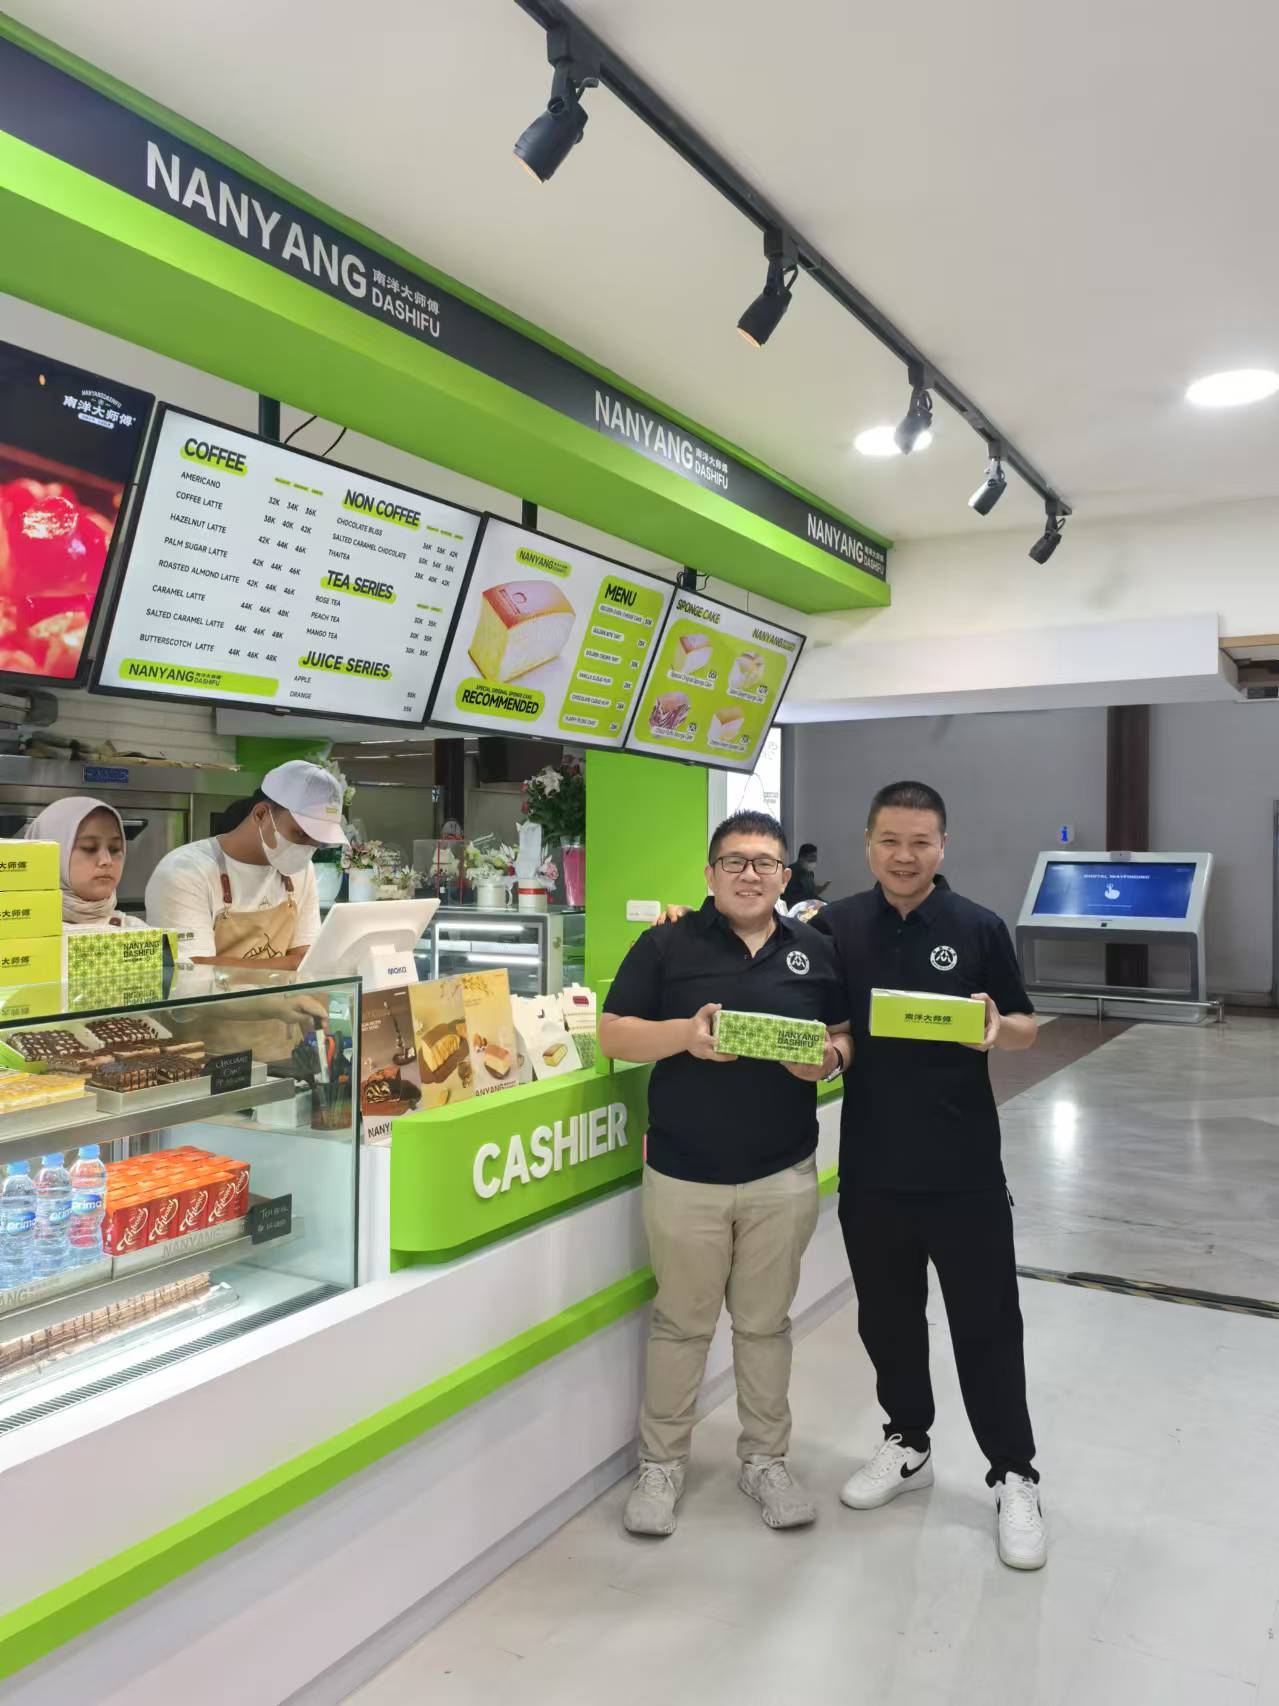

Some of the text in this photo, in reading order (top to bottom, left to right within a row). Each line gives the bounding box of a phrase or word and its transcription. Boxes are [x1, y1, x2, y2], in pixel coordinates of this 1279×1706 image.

[147, 140, 367, 298] NANYANG
[372, 268, 440, 316] 南洋大师傅
[371, 287, 440, 338] DASHIFU
[63, 395, 133, 427] 南洋大师傅
[595, 390, 693, 469] NANYANG
[184, 438, 246, 472] COFFEE
[180, 471, 221, 489] AMERICANO
[695, 460, 729, 490] DASHIFU
[176, 490, 223, 510] COFFEE LATTE
[344, 489, 421, 528] NON COFFEE
[304, 505, 317, 517] 36K
[169, 512, 227, 534] HAZELNUT LATTE
[300, 524, 312, 534] 42K
[336, 517, 383, 537] CHOCOLATE BLISS
[164, 536, 228, 558] PALM SUGAR LATTE
[276, 540, 288, 550] 44K
[332, 532, 407, 560] SALTED CARAMEL CHOCOLATE
[808, 513, 864, 564] NANYANG
[519, 550, 553, 569] NANYANG
[863, 555, 884, 575] DASHIFU
[158, 559, 240, 584] ROASTED ALMOND LATTE
[152, 584, 206, 601] CARAMEL LATTE
[327, 569, 394, 601] TEA SERIES
[604, 583, 637, 607] MENU
[315, 595, 341, 608] ROSE TEA
[146, 608, 225, 629] SALTED CARAMEL LATTE
[311, 611, 340, 624] PEACH TEA
[676, 599, 721, 625] SPONGE CAKE
[140, 633, 214, 652] BUTTERSCOTCH LATTE
[306, 627, 338, 641] MANGO TEA
[752, 627, 785, 649] NANYANG
[129, 663, 194, 682] NANYANG
[303, 650, 390, 677] JUICE SERIES
[194, 677, 220, 687] DASHIFU
[294, 675, 312, 684] APPLE
[289, 690, 312, 700] ORANGE
[462, 689, 539, 715] RECOMMENDED
[0, 909, 31, 918] 大师傅
[123, 941, 160, 951] NANYANG
[123, 948, 155, 958] DASHIFU
[777, 1037, 813, 1048] DASHIFU
[778, 1030, 820, 1042] NANYANG
[472, 1102, 628, 1199] CASHIER
